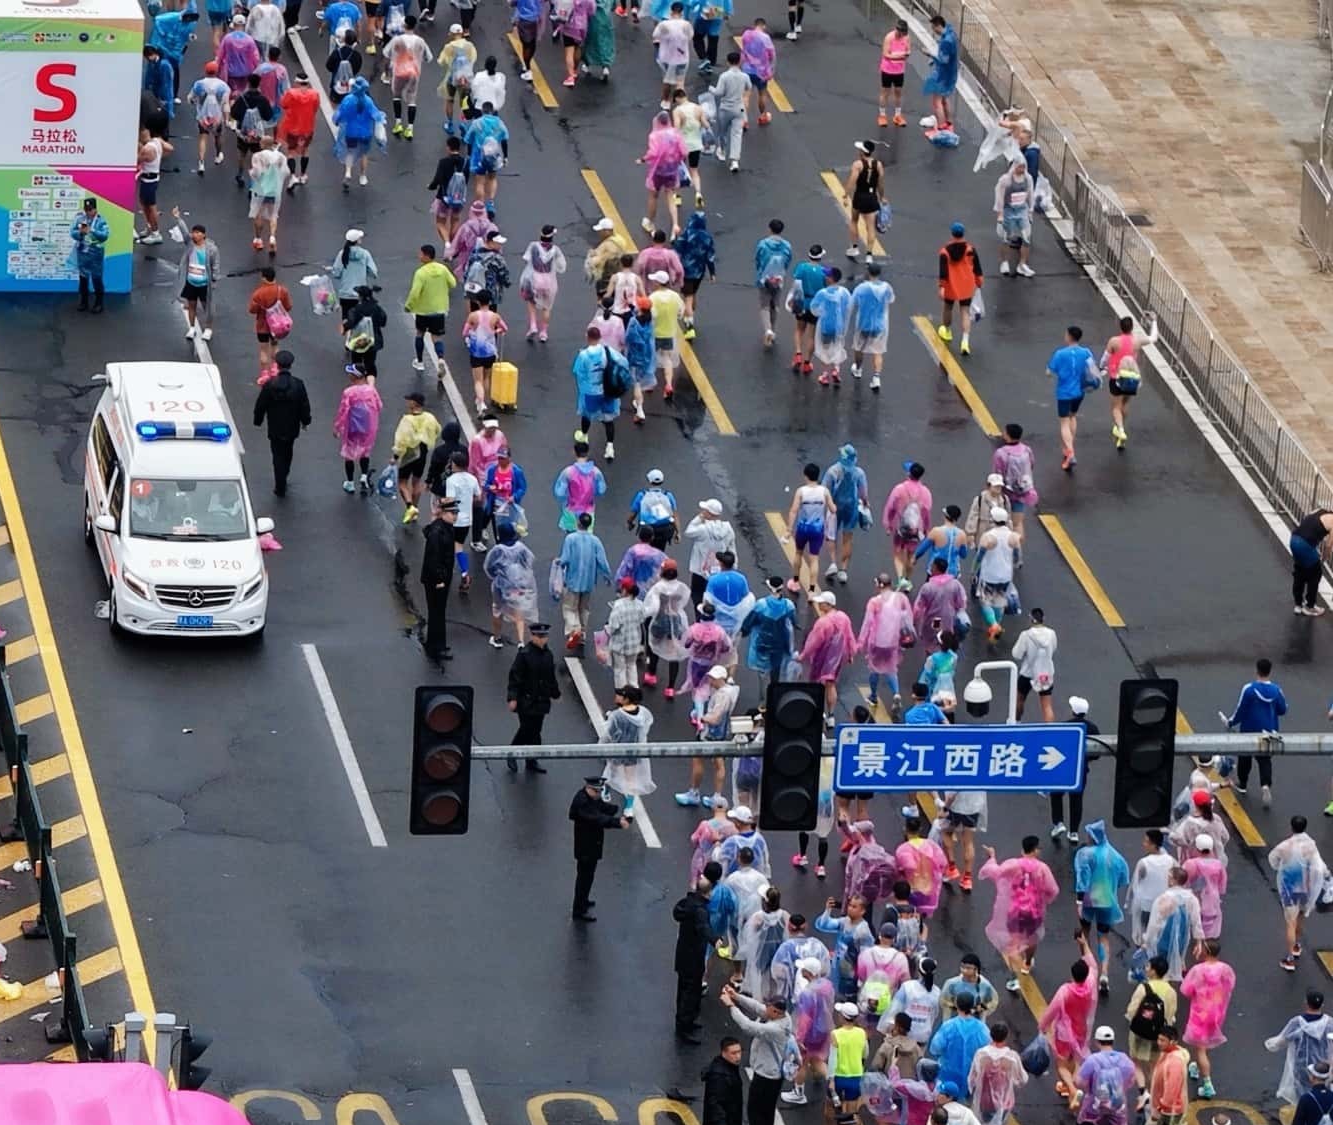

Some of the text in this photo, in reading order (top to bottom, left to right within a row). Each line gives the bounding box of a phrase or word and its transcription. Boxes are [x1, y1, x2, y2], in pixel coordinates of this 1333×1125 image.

[33, 63, 77, 123] S
[31, 129, 78, 143] 马拉松
[22, 145, 85, 154] MARATHON
[145, 400, 206, 413] 120
[136, 483, 144, 494] 1
[213, 559, 242, 570] 120
[853, 743, 1027, 777] 景江西路
